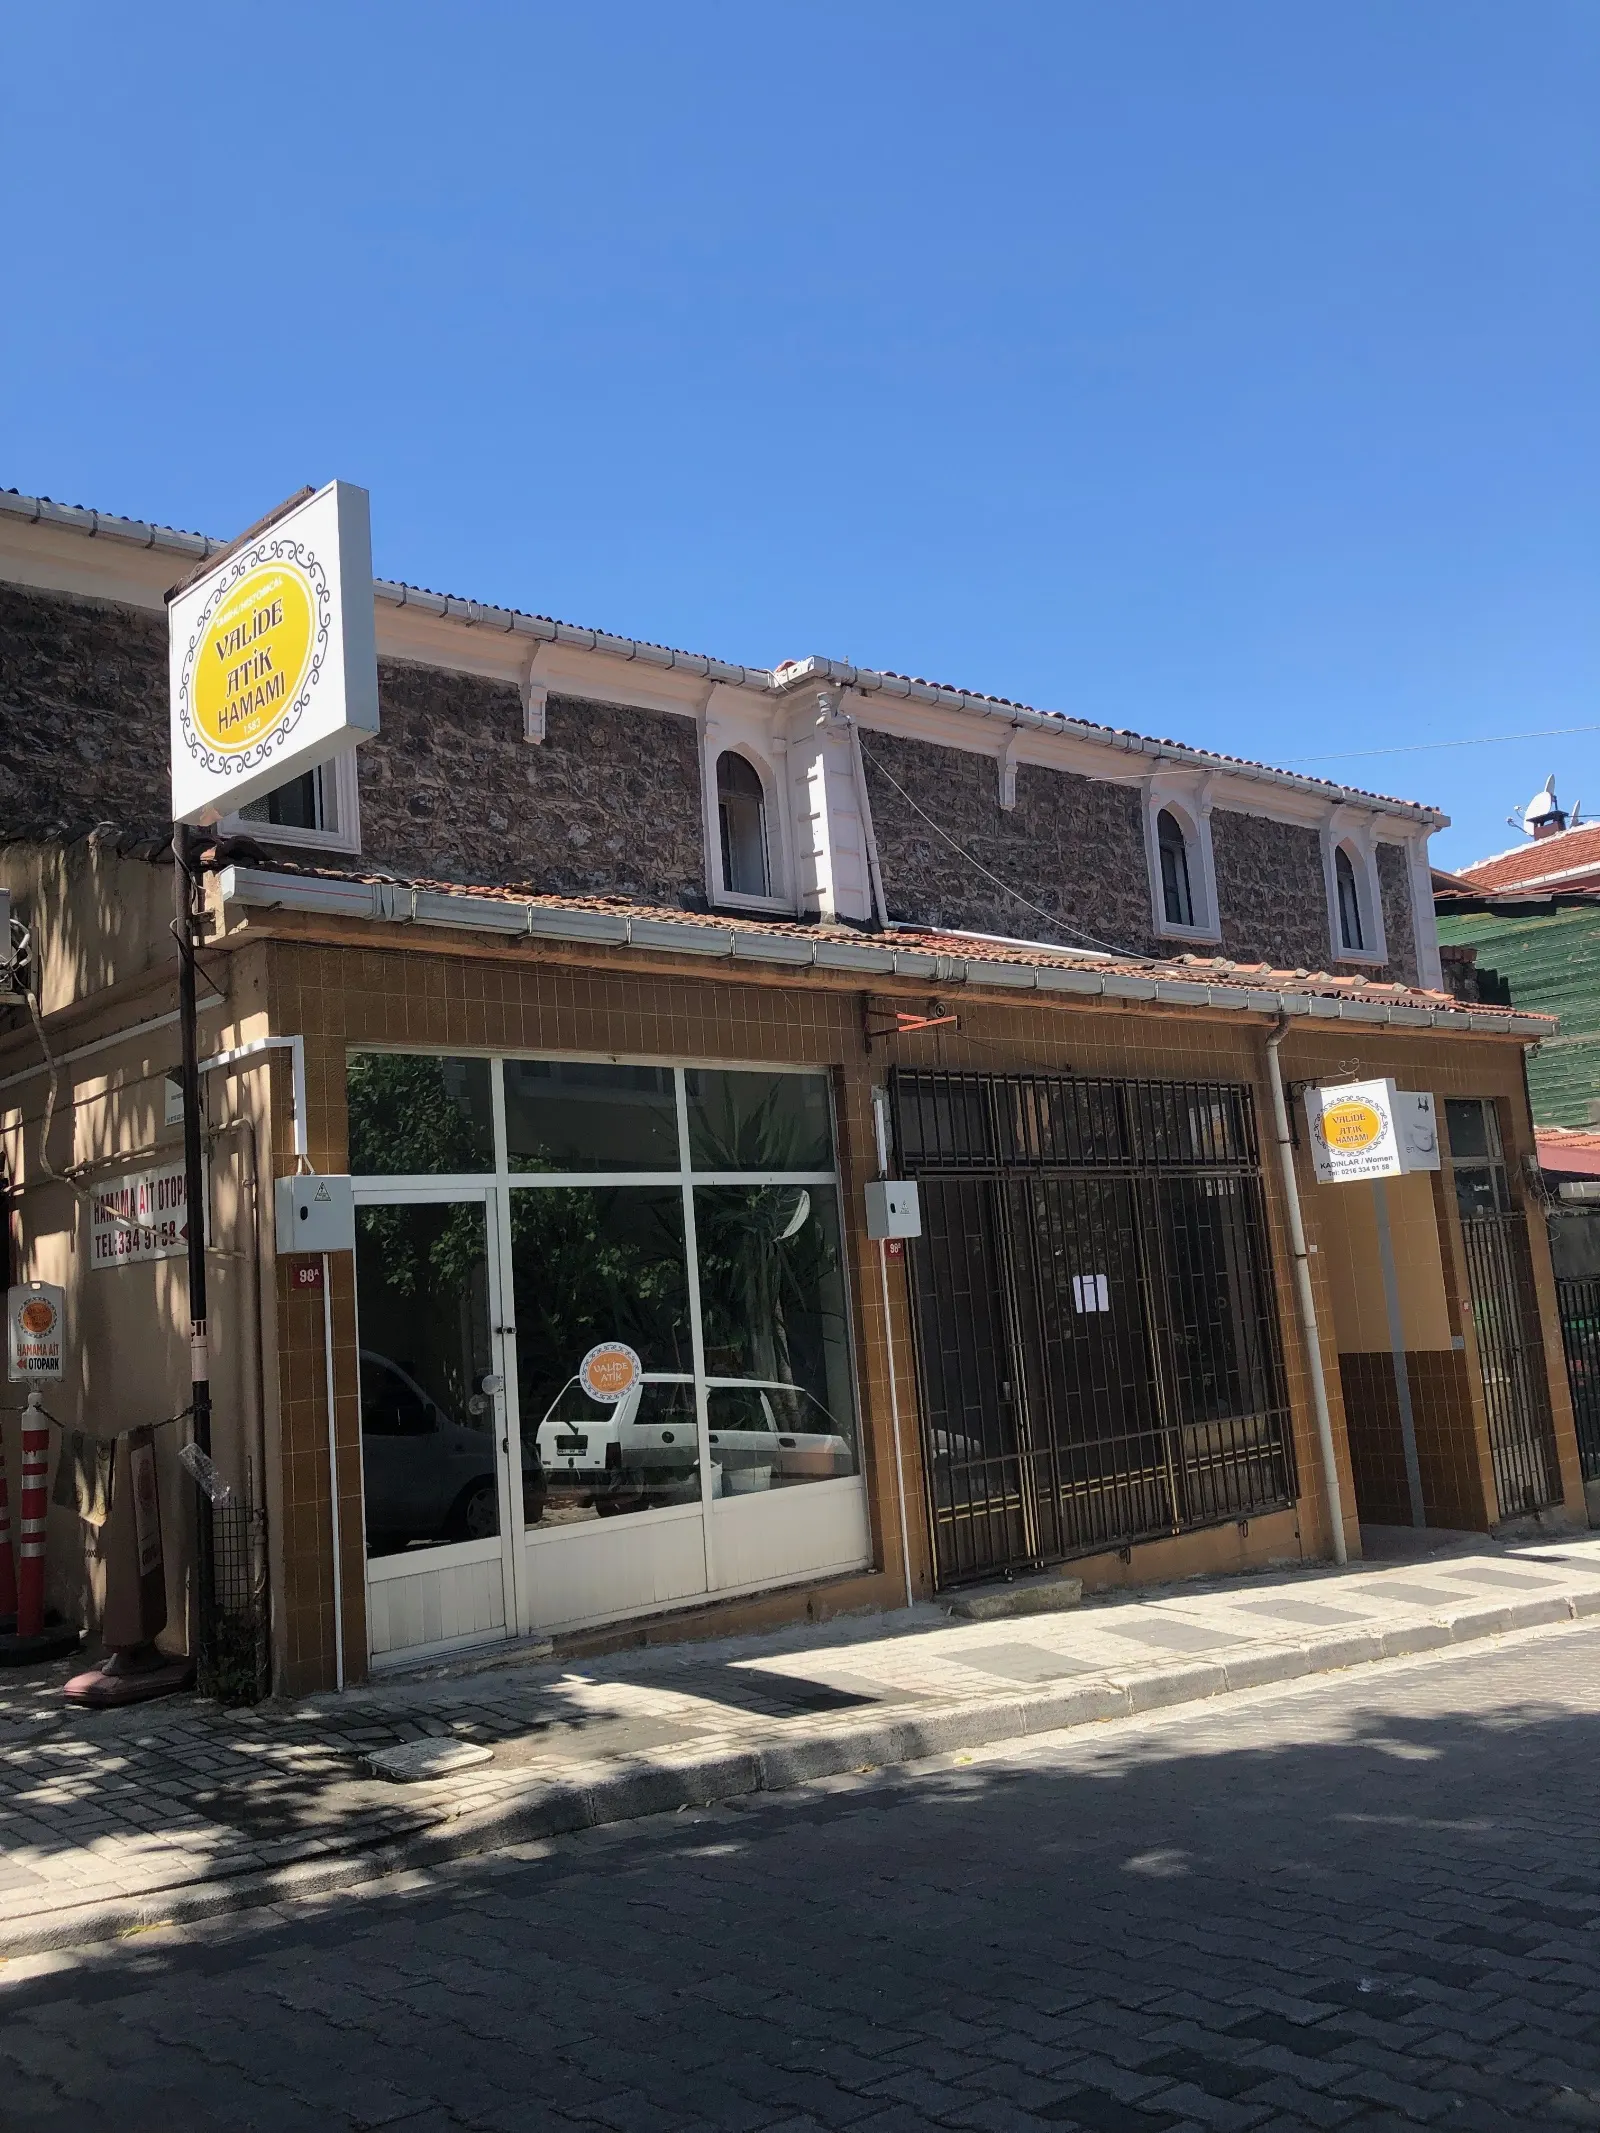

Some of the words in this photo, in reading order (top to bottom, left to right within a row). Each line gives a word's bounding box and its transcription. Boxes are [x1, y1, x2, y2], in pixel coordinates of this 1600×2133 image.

[215, 598, 283, 661] VALİDE
[226, 646, 272, 697] ATİK
[218, 671, 285, 733] HAMAMI
[1332, 1112, 1366, 1124] VALİDE
[1336, 1133, 1369, 1145] HAMAMI
[1320, 1158, 1360, 1169] KADINLAR
[1365, 1155, 1393, 1164] Women
[1341, 1167, 1357, 1175] 0216
[94, 1187, 136, 1225] HAMAMA
[140, 1176, 154, 1215] AİT
[17, 1343, 47, 1357] HAMAMA
[49, 1341, 59, 1357] AİT
[28, 1357, 59, 1370] OTOPARK
